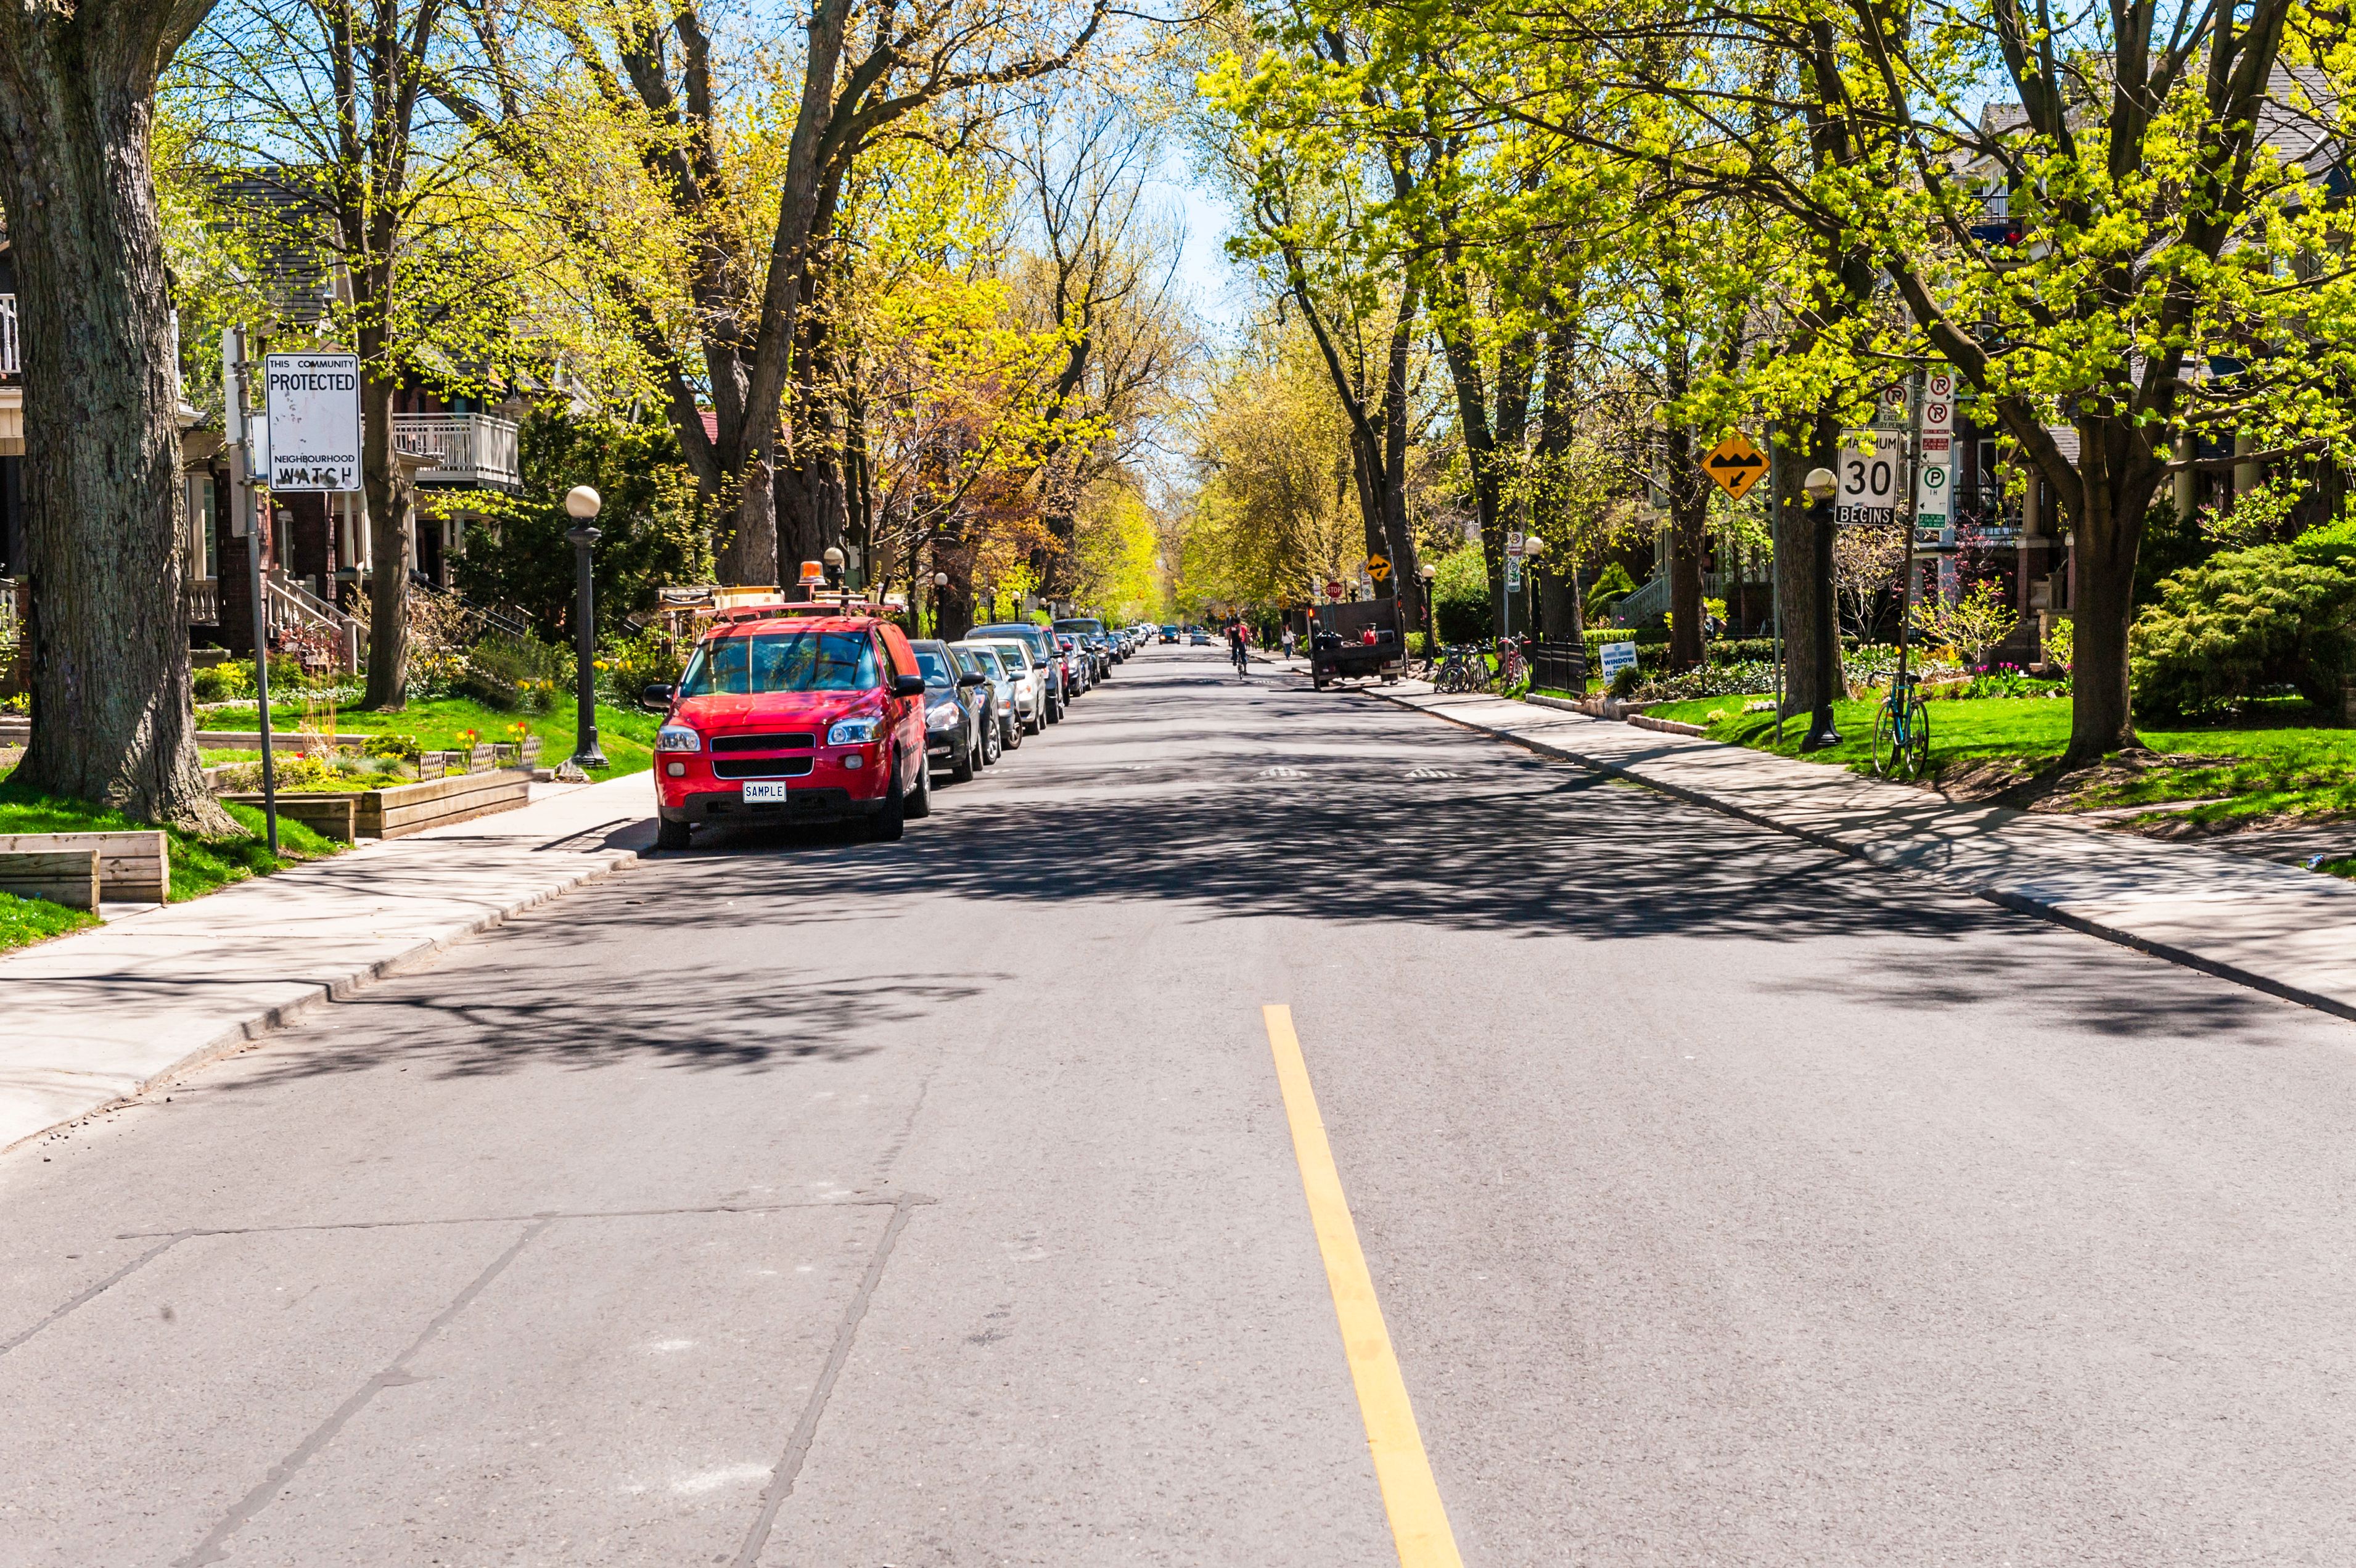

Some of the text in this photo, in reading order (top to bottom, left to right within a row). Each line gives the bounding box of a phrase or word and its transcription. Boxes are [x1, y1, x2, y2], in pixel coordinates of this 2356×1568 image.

[270, 360, 354, 368] THIS COMMUNITY
[270, 374, 355, 390] PROTECTED
[274, 454, 355, 463] NEIGHBOURHOOD
[279, 467, 351, 484] WATCH
[1845, 460, 1891, 496] 30
[1931, 472, 1940, 483] P
[1841, 507, 1890, 523] BEGINS
[1604, 657, 1634, 665] WINDOW
[746, 786, 782, 797] SAMPLE
